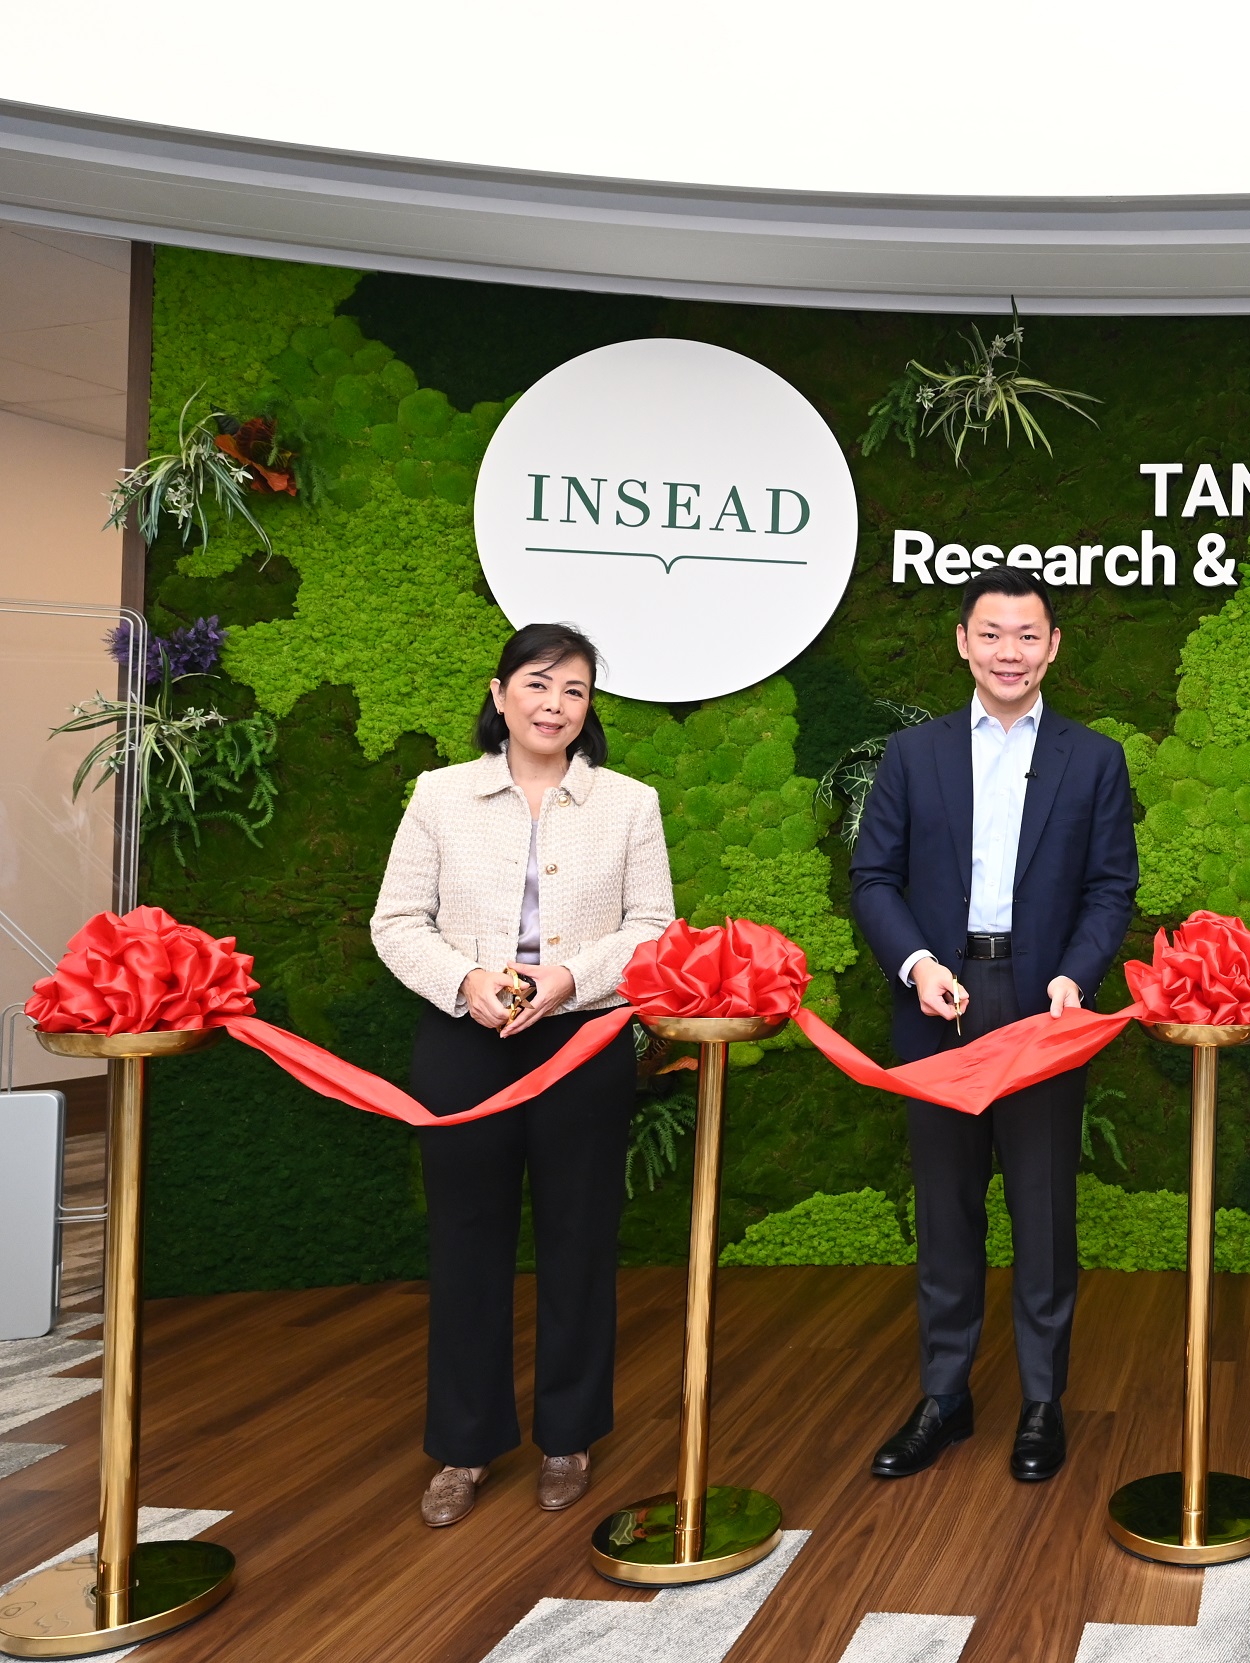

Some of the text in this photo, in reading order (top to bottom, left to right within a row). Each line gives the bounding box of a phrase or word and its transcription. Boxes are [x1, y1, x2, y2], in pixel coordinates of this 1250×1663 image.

[525, 473, 811, 535] INSEAD
[892, 529, 1176, 588] Research
[1193, 532, 1238, 586] &
